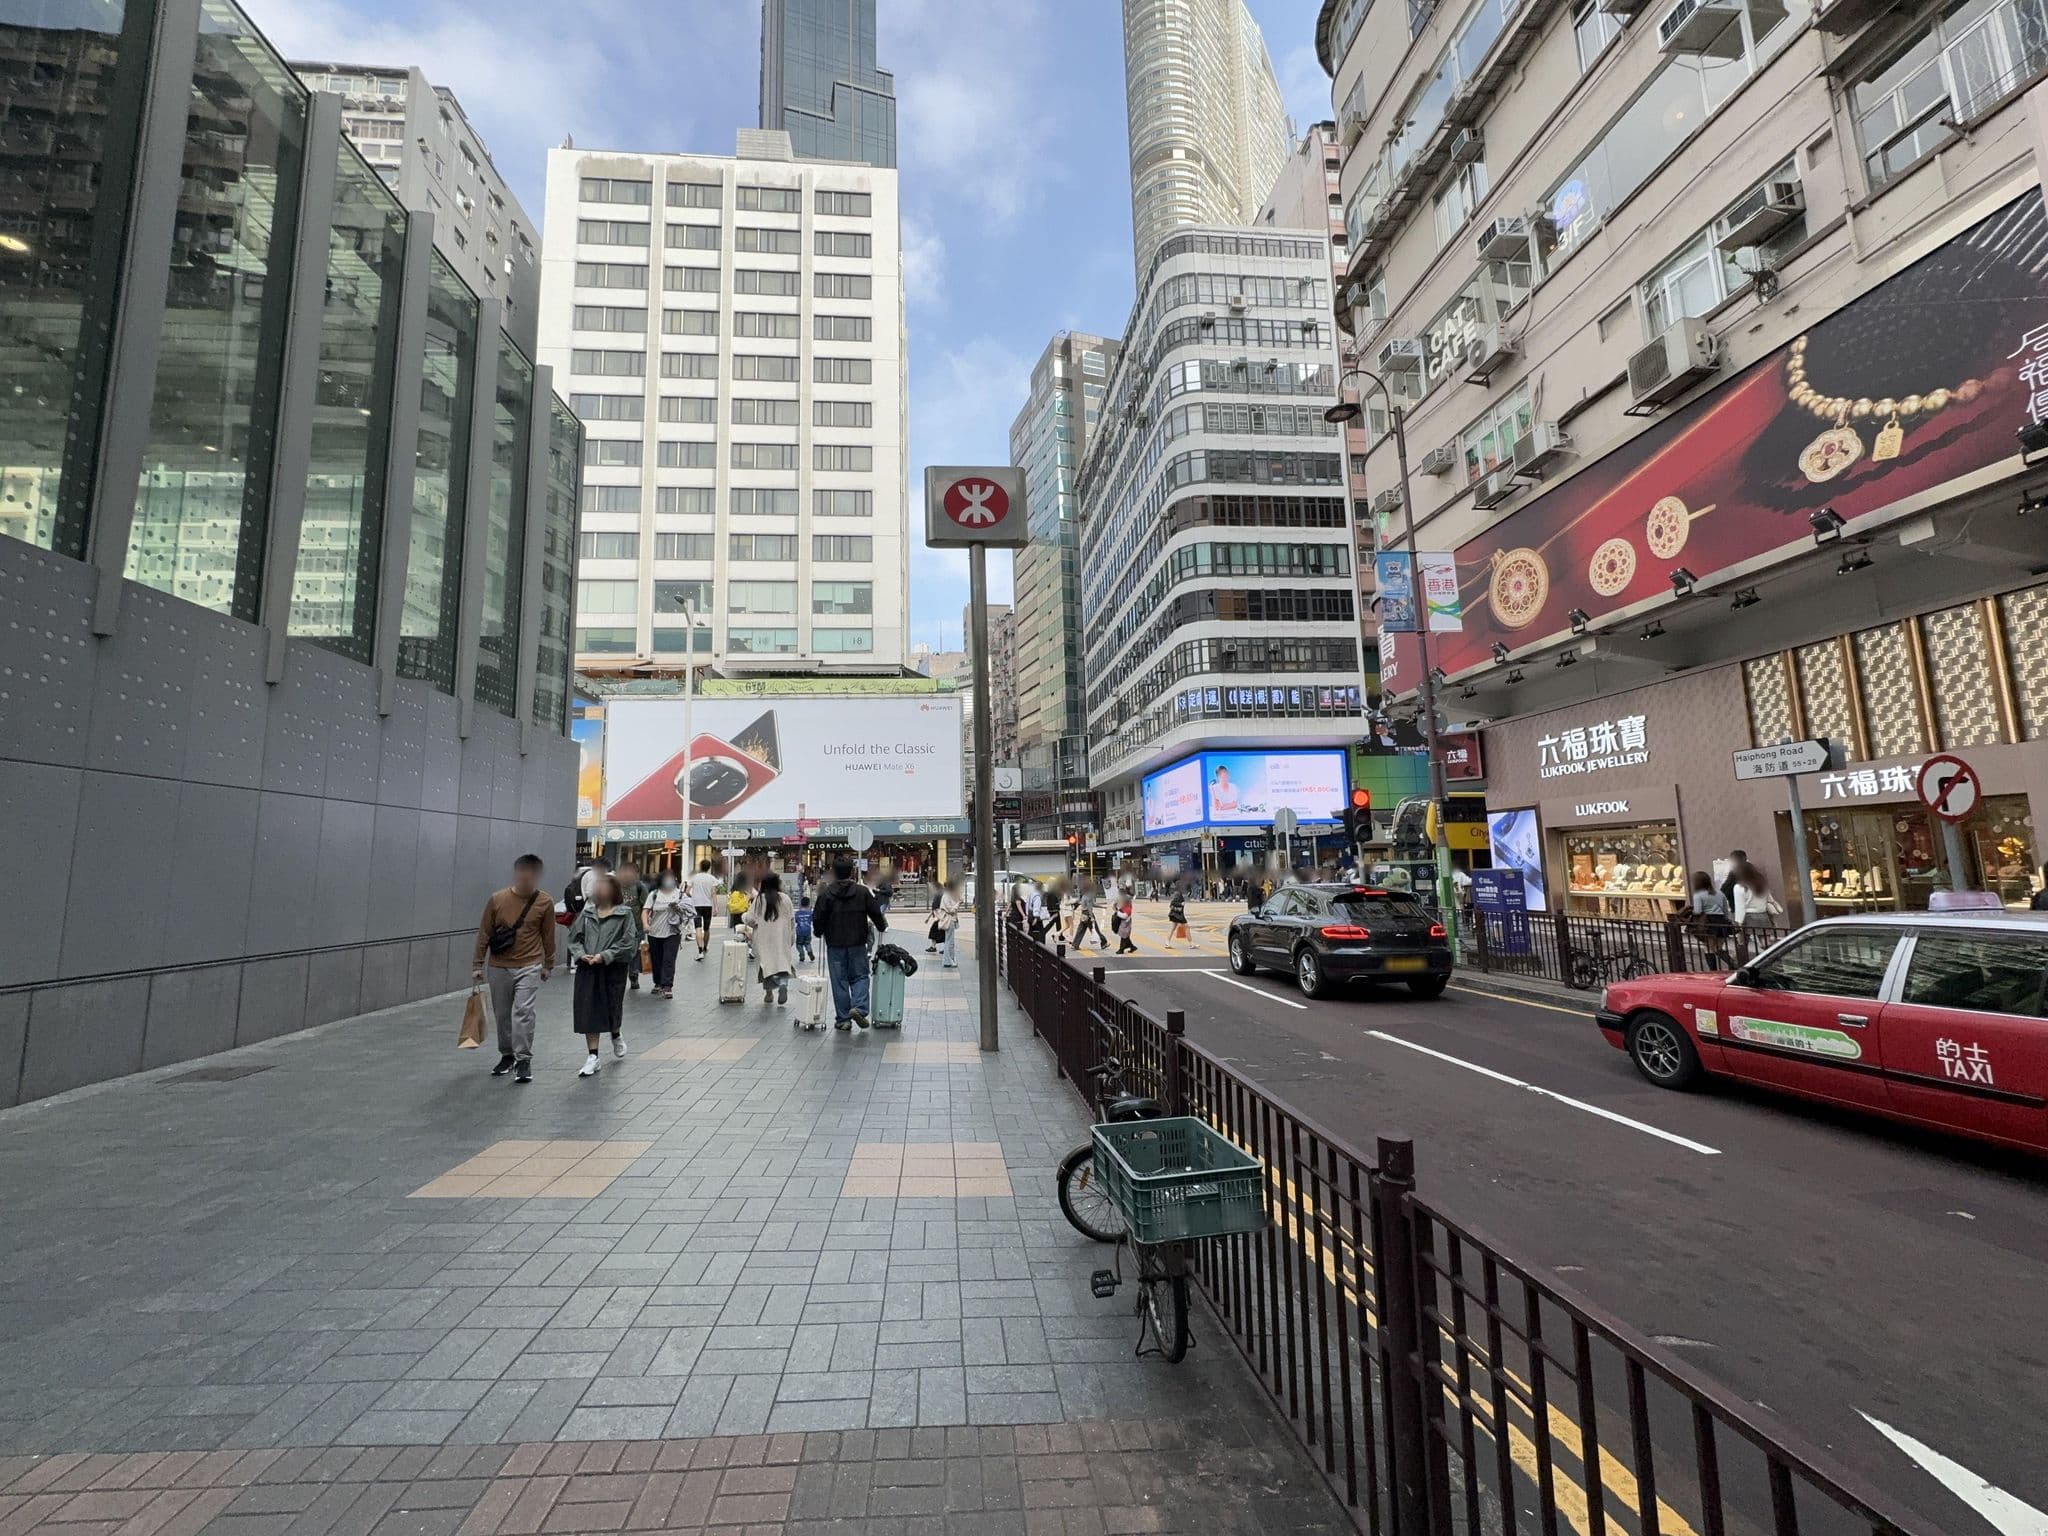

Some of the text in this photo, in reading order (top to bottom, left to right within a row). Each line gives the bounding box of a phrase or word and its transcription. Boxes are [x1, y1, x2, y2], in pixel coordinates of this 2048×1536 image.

[1430, 301, 1466, 353] CAT
[1428, 319, 1476, 380] CAFE
[823, 743, 936, 755] Unfold the Classic
[1537, 715, 1646, 766] 六福珠寶
[1735, 746, 1804, 763] Haiphong Road
[845, 763, 881, 771] HUAWEI
[1540, 751, 1650, 778] LUKFOOK JEWELLERY
[1752, 760, 1789, 774] 海防道
[1575, 800, 1630, 816] LUKFOOK
[628, 829, 668, 840] shama
[919, 822, 955, 833] shama
[1935, 1037, 1989, 1064] 的士
[1937, 1056, 1994, 1085] TAXI
